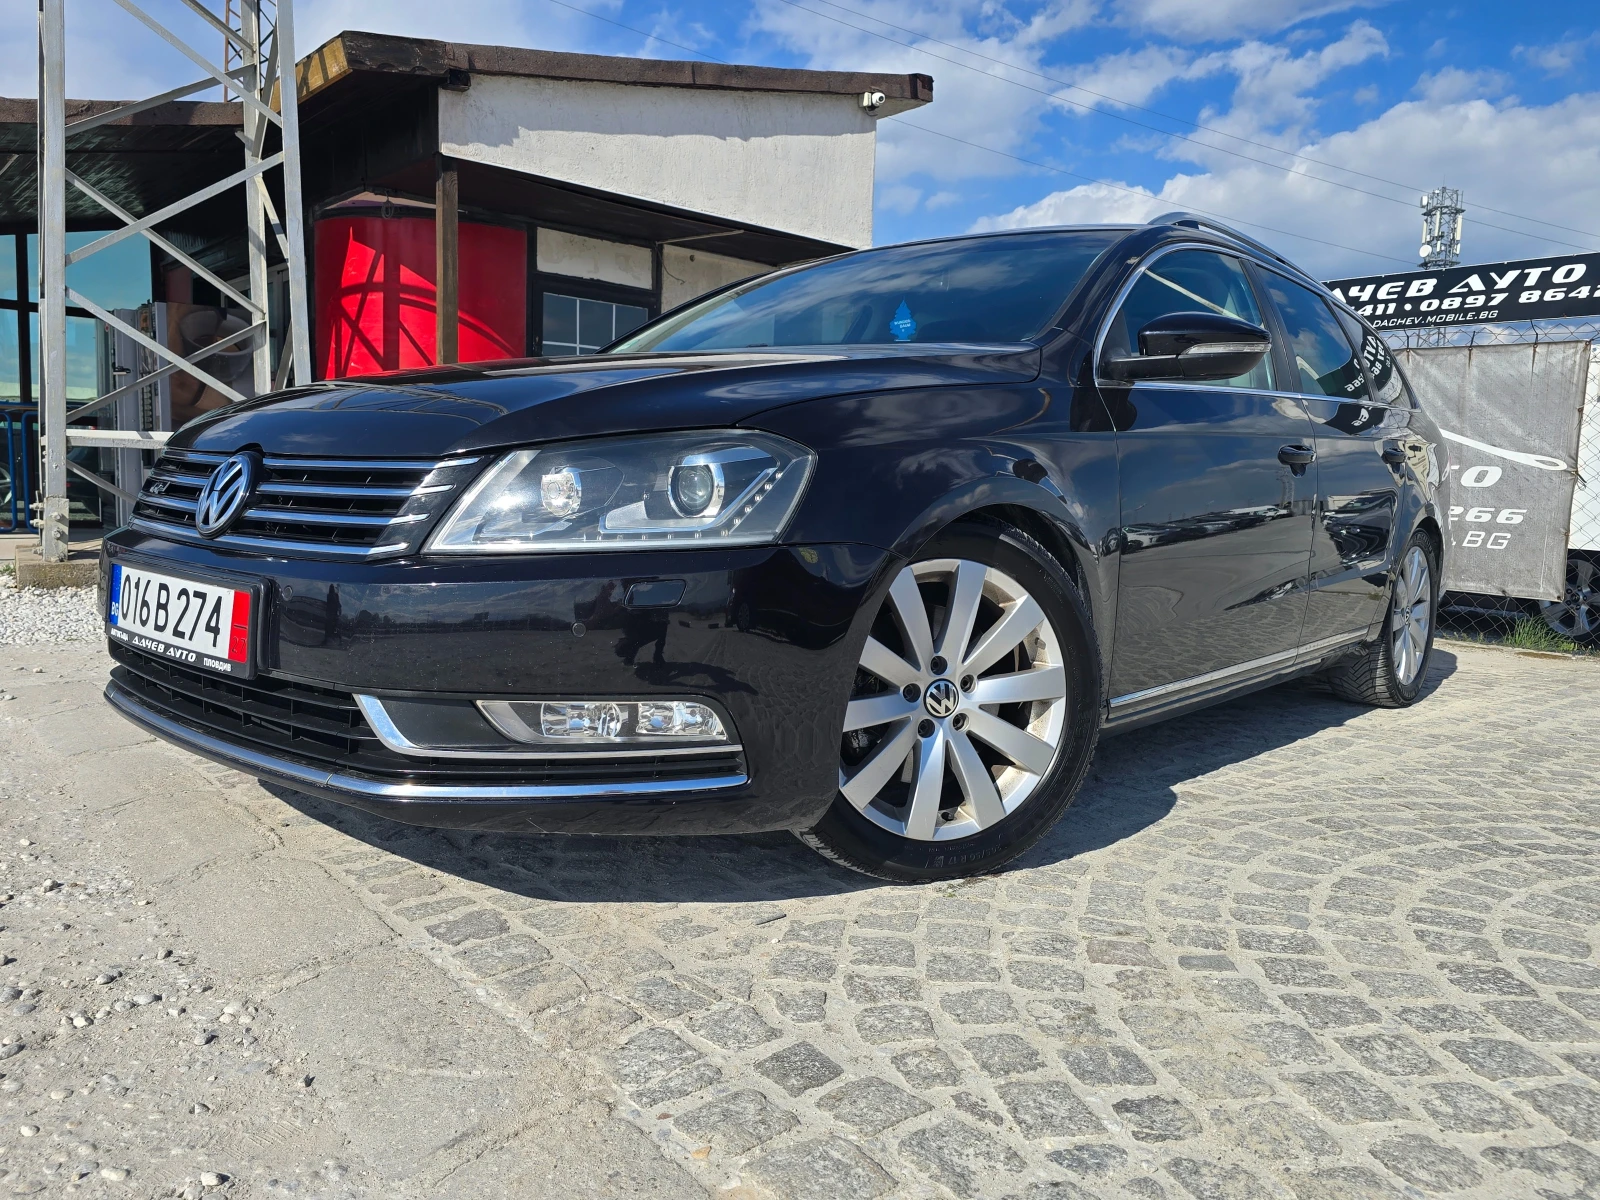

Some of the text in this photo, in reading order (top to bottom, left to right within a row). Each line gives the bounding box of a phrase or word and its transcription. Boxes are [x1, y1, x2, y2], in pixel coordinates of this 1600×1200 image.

[1351, 302, 1397, 317] 411
[1419, 292, 1509, 312] 0897
[1372, 310, 1499, 328] DACHEV.MOBILE.BG
